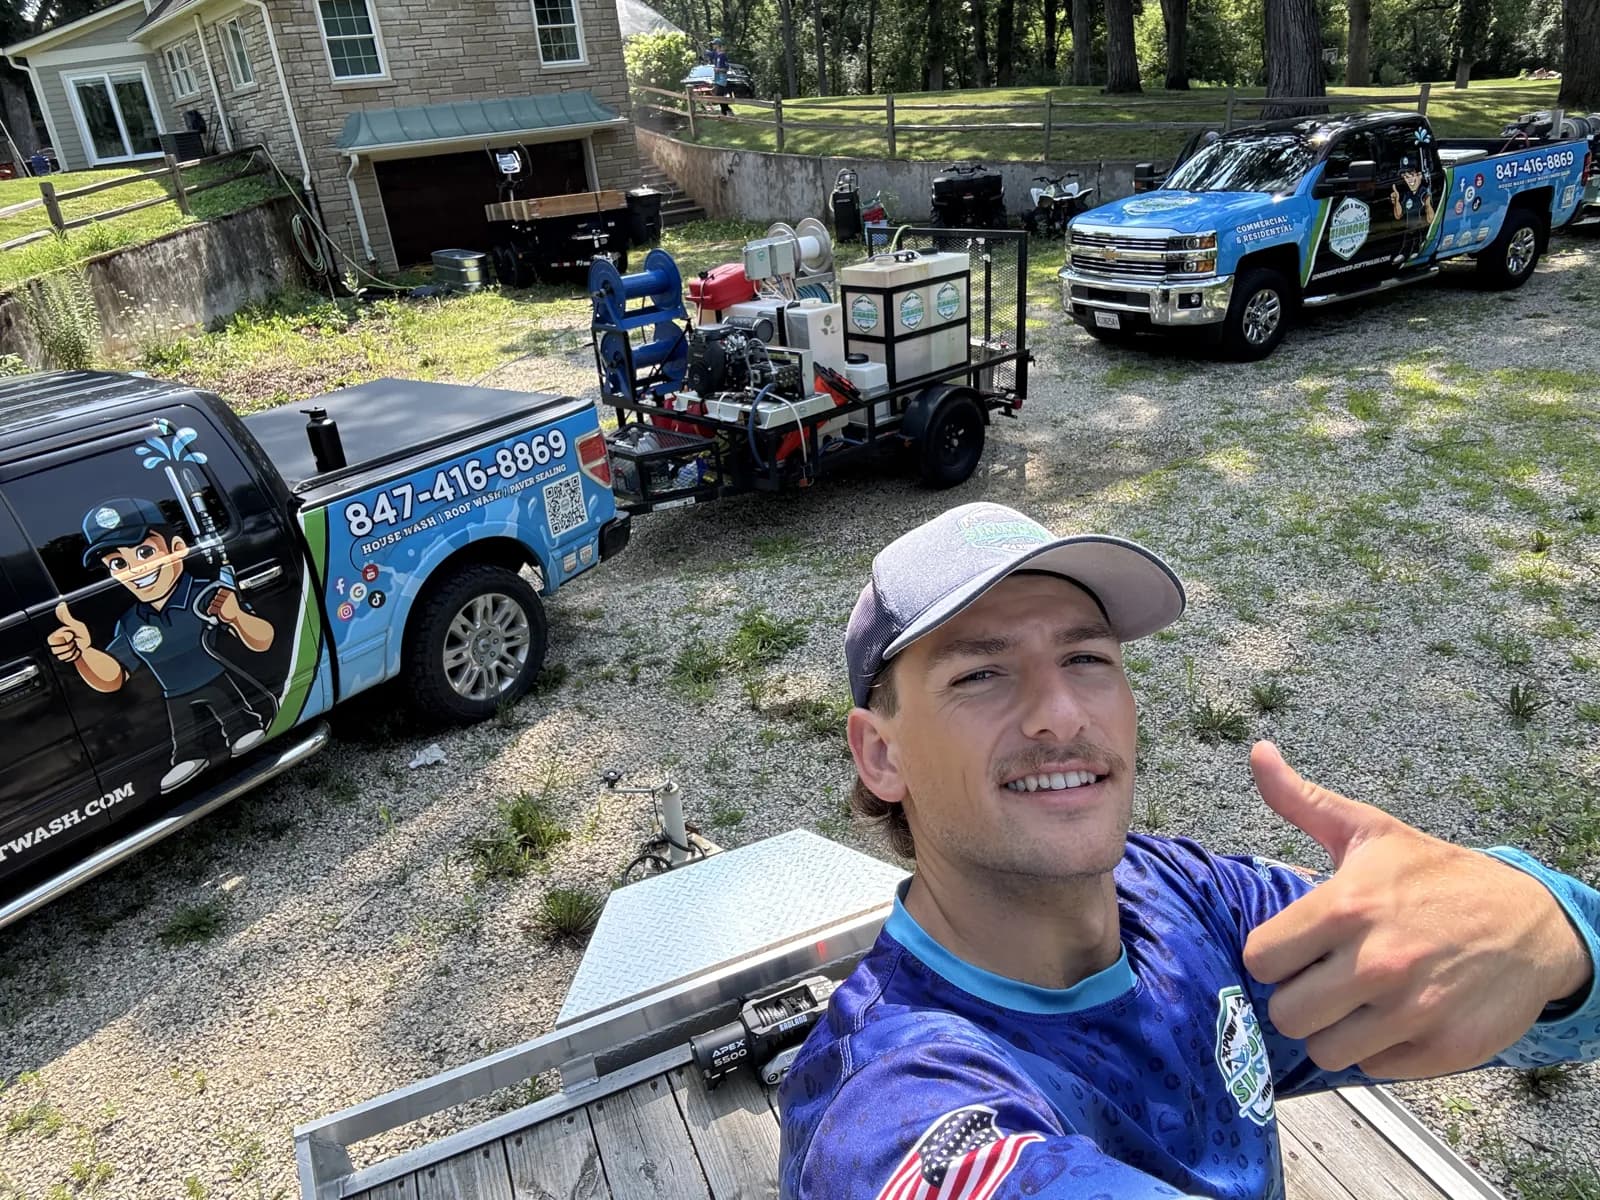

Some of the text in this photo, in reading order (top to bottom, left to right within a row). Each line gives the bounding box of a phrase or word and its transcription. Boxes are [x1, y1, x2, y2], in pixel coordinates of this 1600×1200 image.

[1496, 151, 1574, 179] 847-416-8869
[1236, 215, 1288, 233] COMMERCIAL
[1242, 224, 1293, 242] RESIDENTIAL
[345, 428, 567, 537] 847-416-8869
[362, 531, 402, 555] HOUSE
[403, 517, 437, 538] WASH
[473, 490, 502, 508] WASH
[510, 476, 535, 494] PAVER
[535, 463, 567, 480] SEALING
[712, 1038, 746, 1058] APEX
[713, 1048, 748, 1067] 5500
